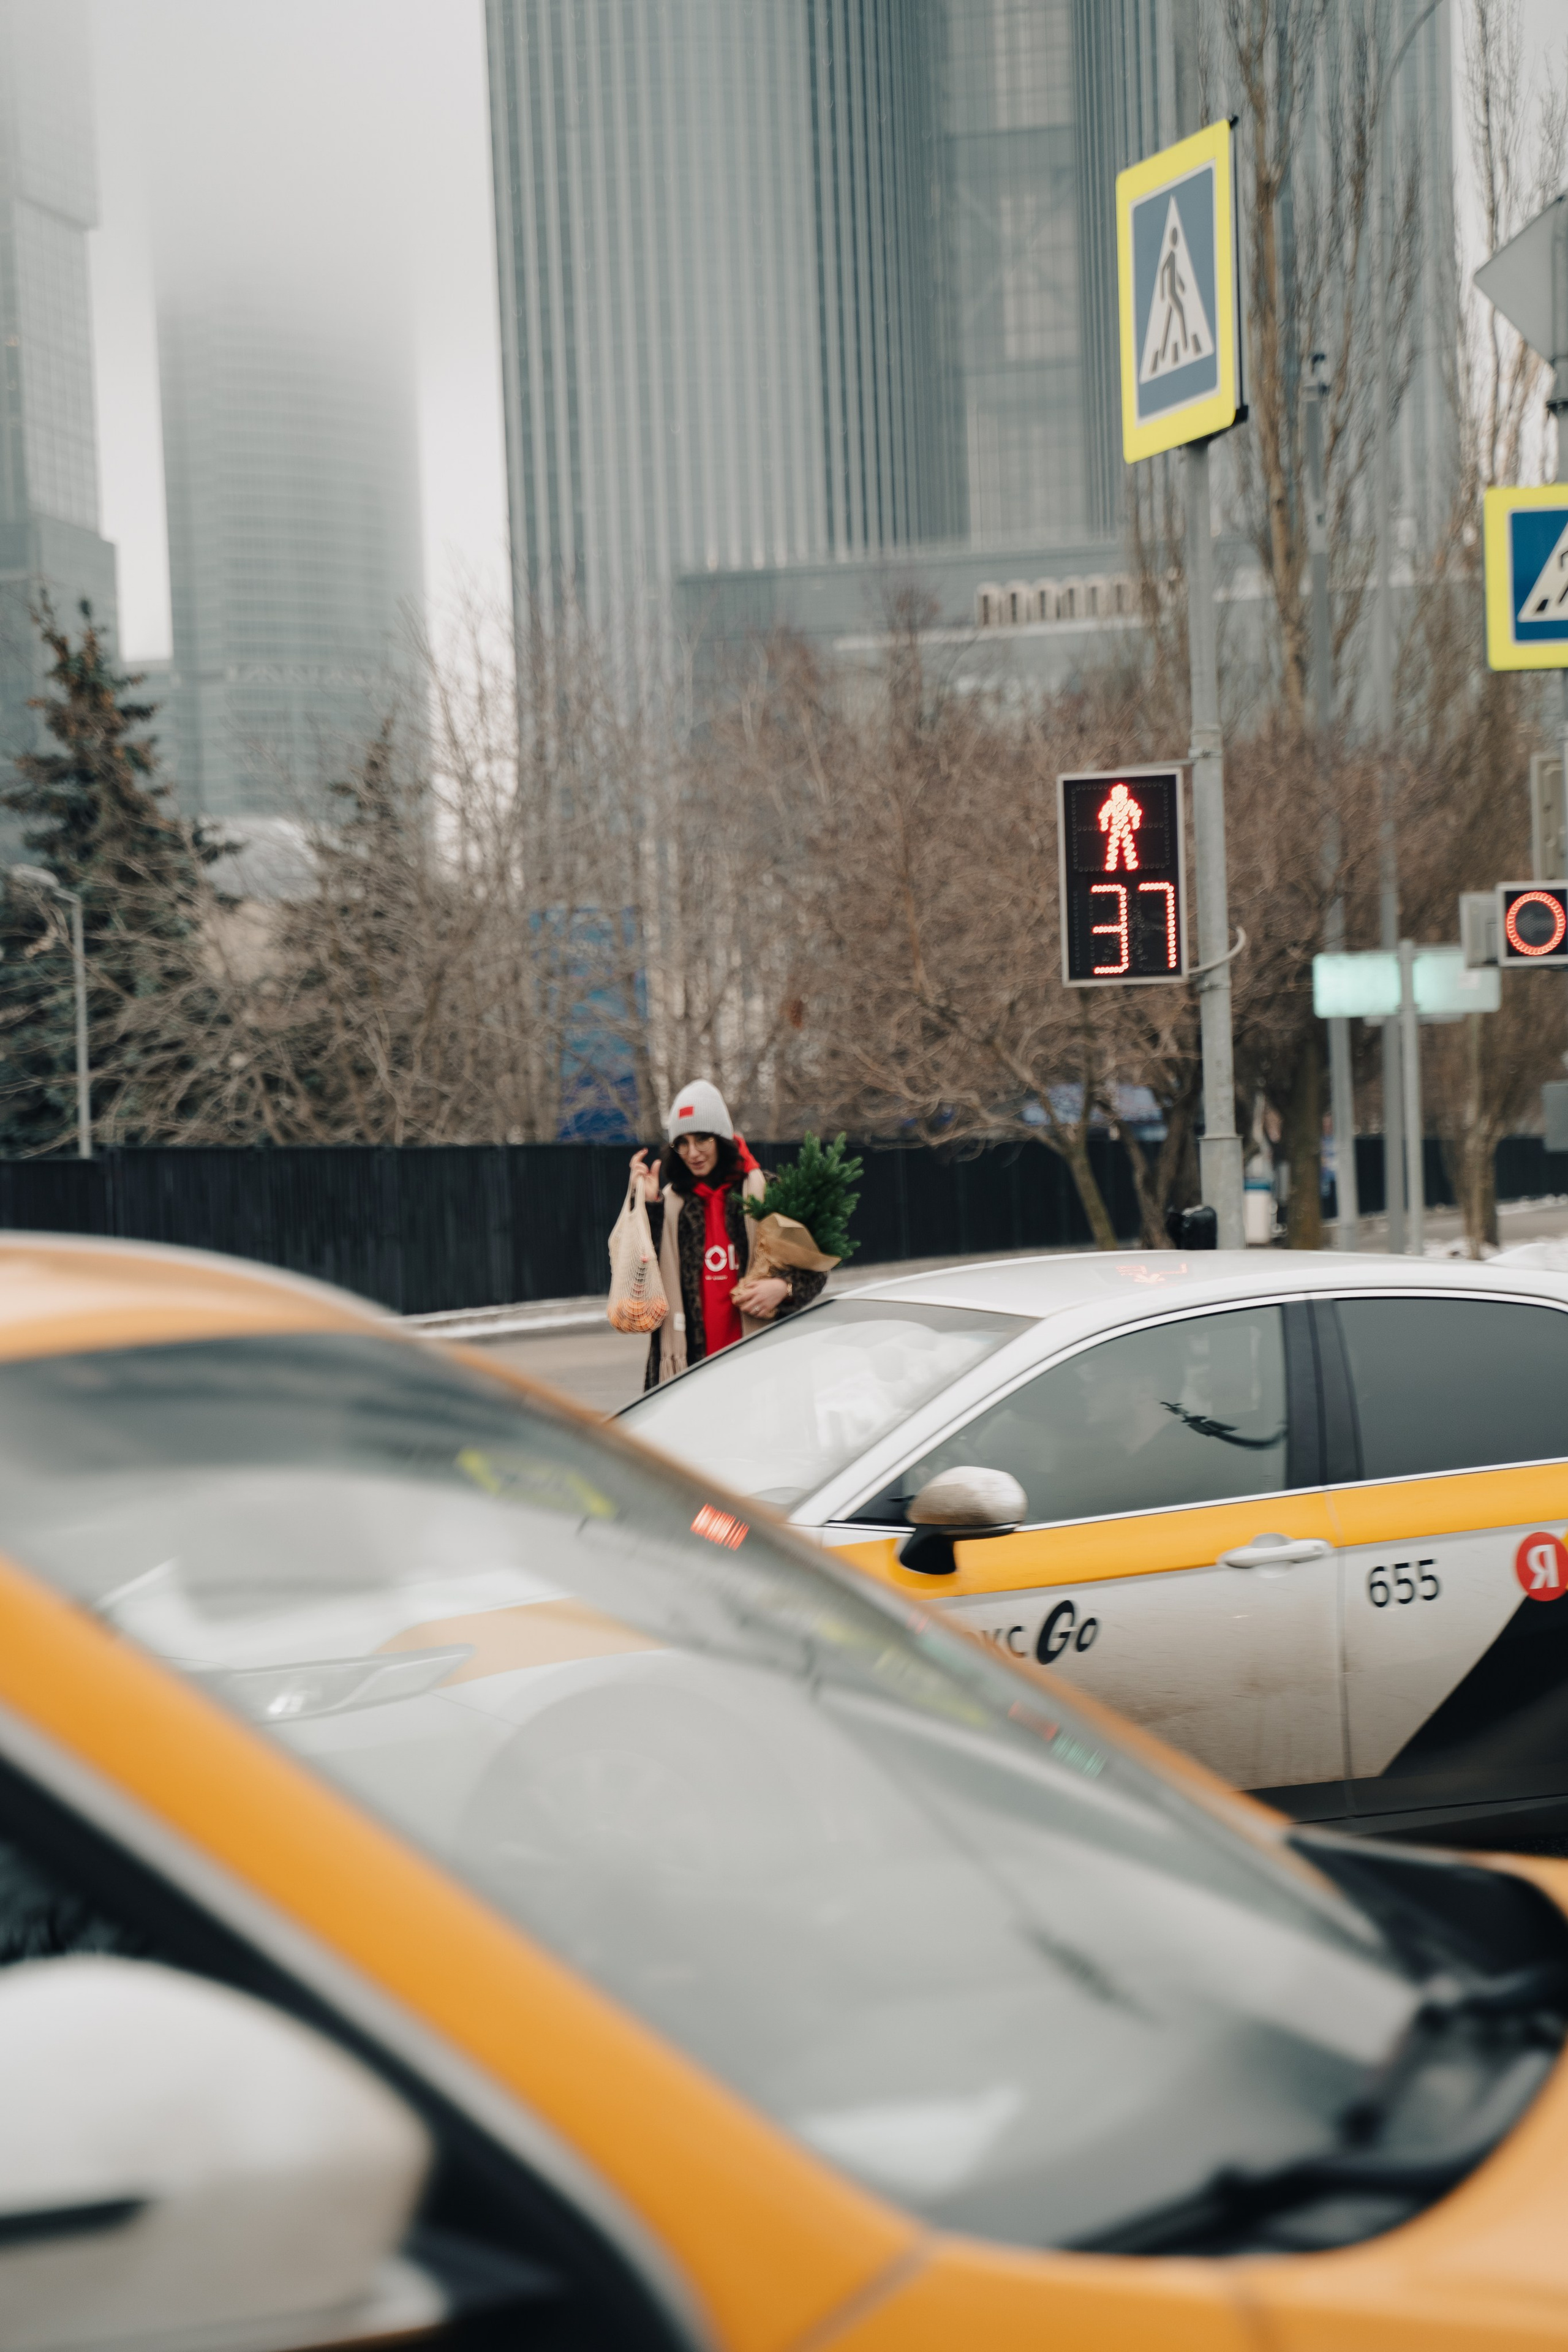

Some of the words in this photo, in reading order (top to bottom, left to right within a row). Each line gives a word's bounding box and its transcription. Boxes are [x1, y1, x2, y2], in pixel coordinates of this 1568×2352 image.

[1091, 881, 1177, 974] 37
[1366, 1559, 1442, 1608] 655
[1526, 1544, 1560, 1590] Я
[1035, 1599, 1099, 1665] Go
